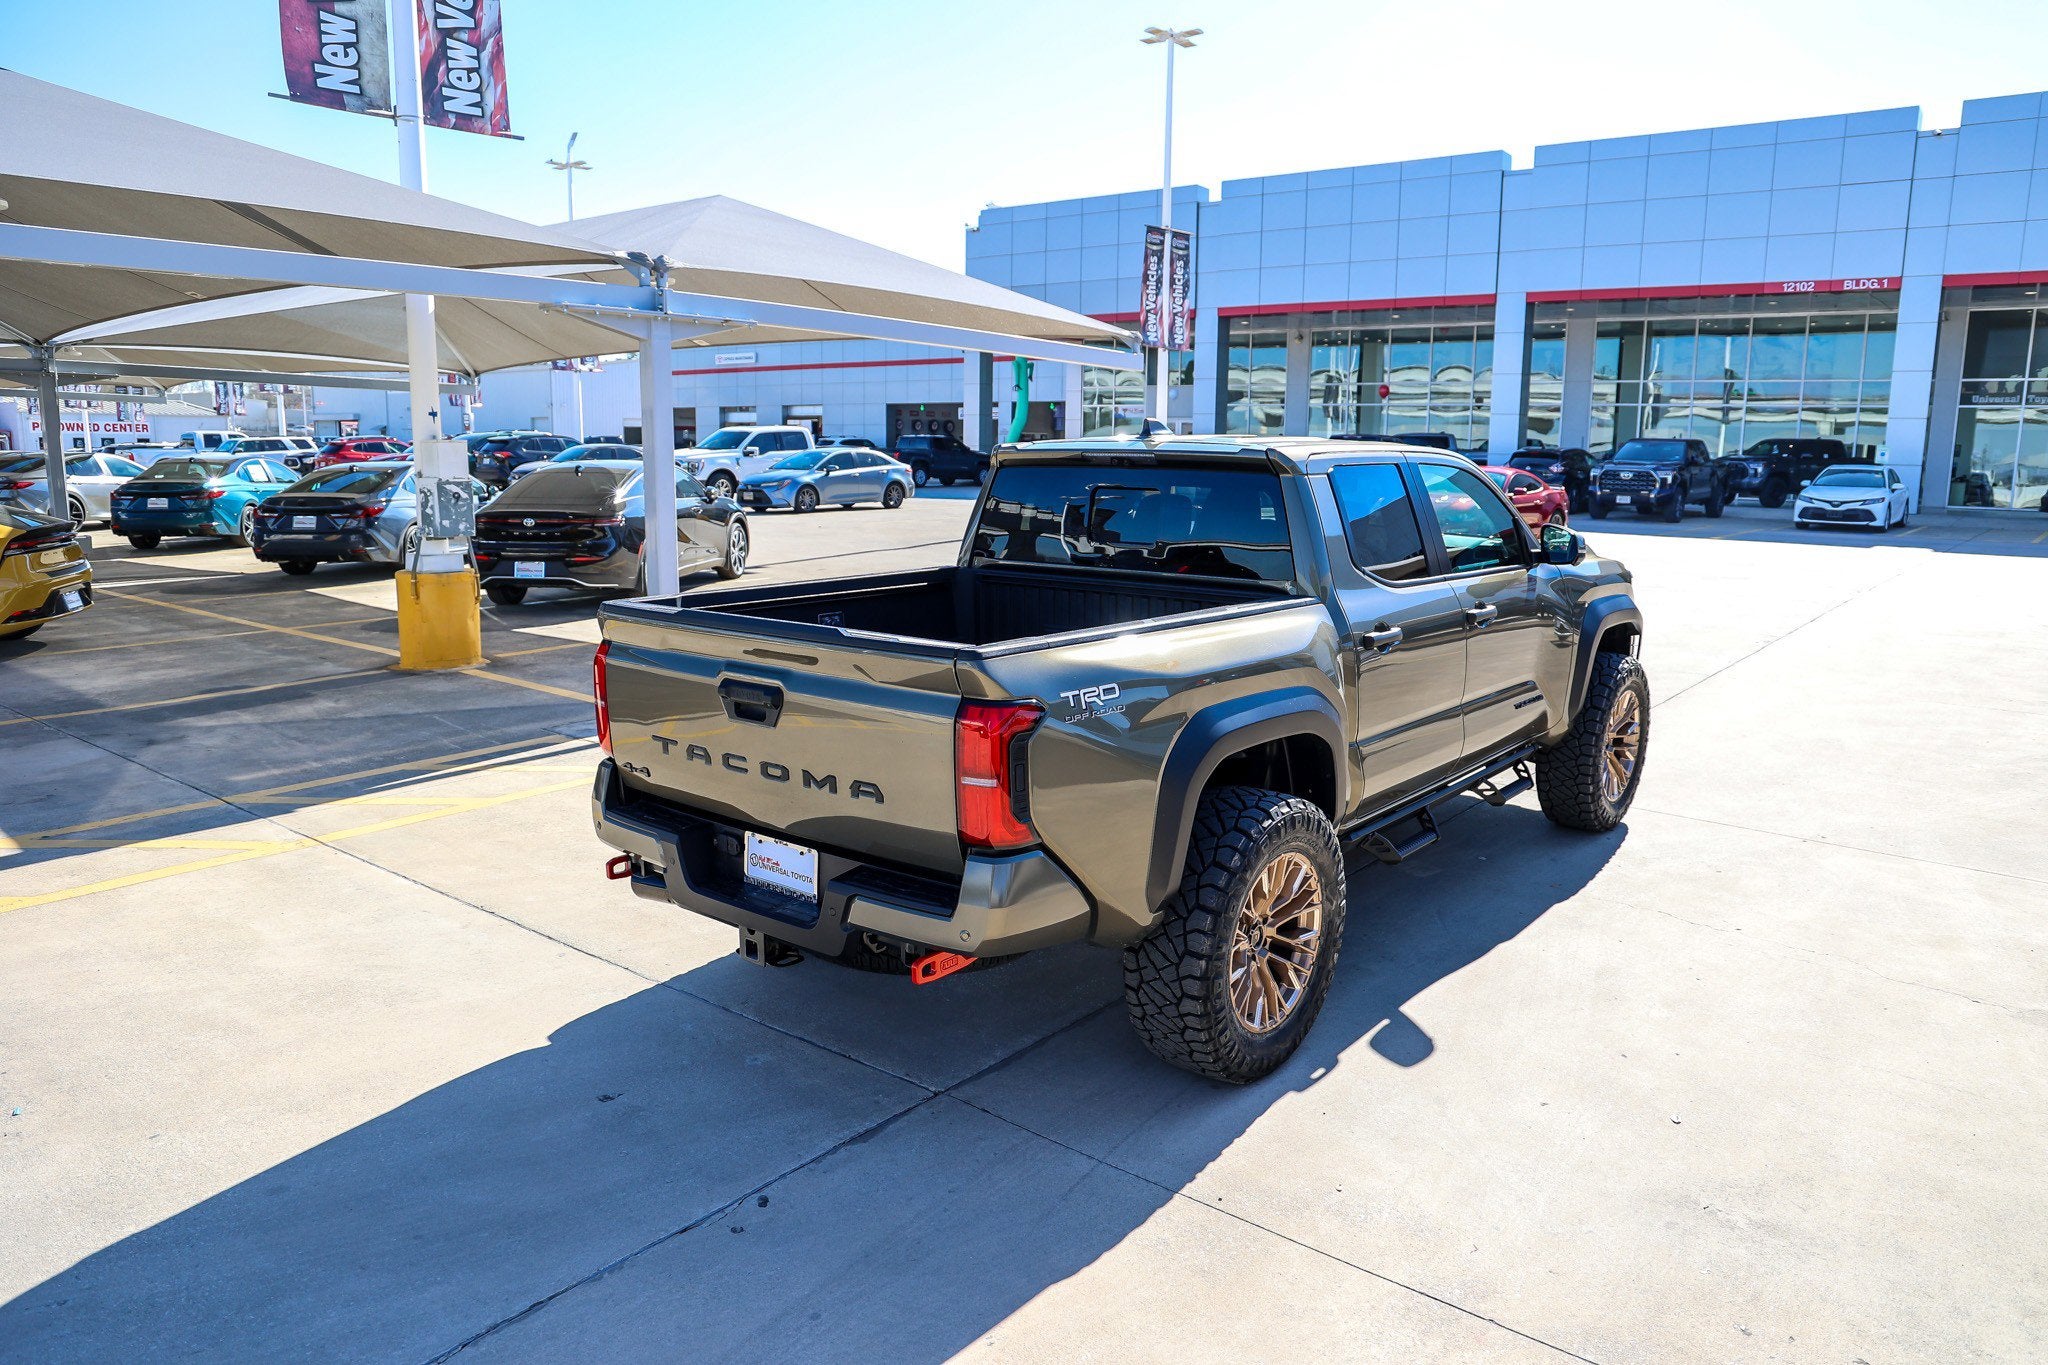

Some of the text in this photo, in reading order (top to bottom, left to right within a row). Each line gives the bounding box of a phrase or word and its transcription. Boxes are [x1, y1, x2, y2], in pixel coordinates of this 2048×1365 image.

[314, 11, 362, 95] New
[441, 37, 483, 117] New
[1145, 255, 1159, 312] Vehicles
[1172, 260, 1185, 316] Vehicles
[1782, 281, 1815, 292] 12102
[1882, 278, 1889, 288] 1
[1145, 315, 1159, 342] New
[1173, 318, 1185, 344] New
[1972, 394, 2021, 404] Universal
[104, 423, 149, 433] CENTER
[1060, 682, 1120, 710] TRD
[1065, 705, 1126, 724] OFF ROAD
[651, 734, 885, 804] TACOMA
[758, 862, 814, 885] UNIVERSAL TOYOTA
